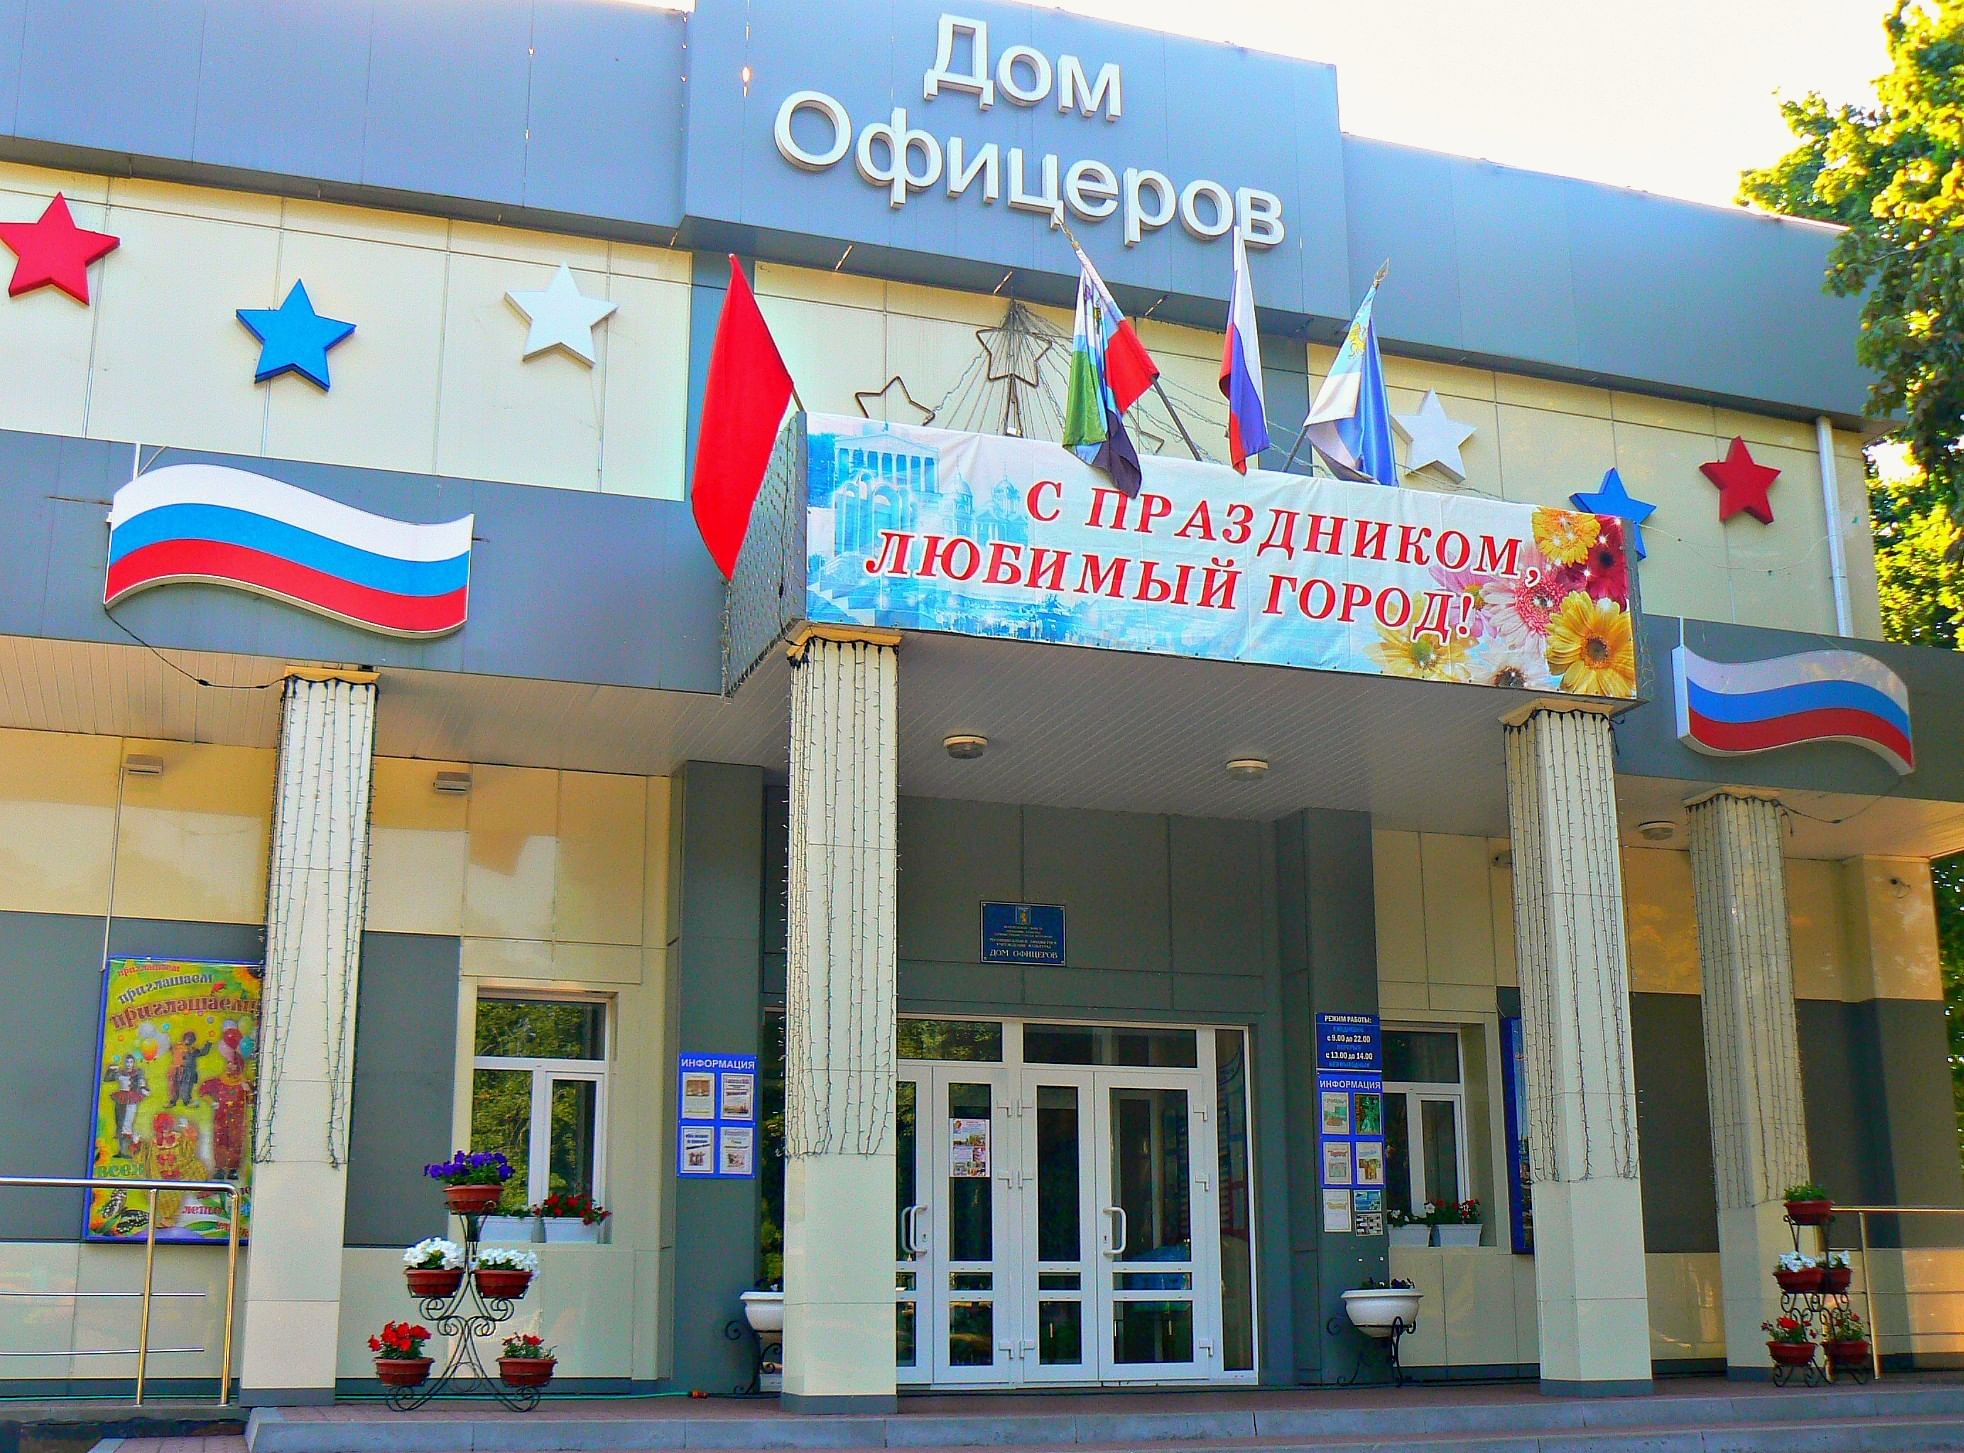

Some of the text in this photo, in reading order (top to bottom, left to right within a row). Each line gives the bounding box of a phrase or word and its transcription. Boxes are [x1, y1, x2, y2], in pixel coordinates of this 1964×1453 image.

[923, 12, 1123, 122] Дом
[773, 89, 1286, 251] Офицеров
[1026, 480, 1541, 587] С ПРАЗДНИКОМ,
[865, 531, 1475, 643] ЛЮБИМЫЙ ГОРОД!
[989, 949, 1009, 958] ДОМ
[1324, 1015, 1372, 1024] РЕЖИМ РАБОТЫ:
[1331, 1034, 1346, 1042] 9.00
[1353, 1035, 1371, 1043] 22.00
[1356, 1052, 1373, 1061] 14.00
[681, 1058, 755, 1070] ИНФОРМАЦИЯ
[1319, 1080, 1381, 1090] ИНФОРМАЦИЯ
